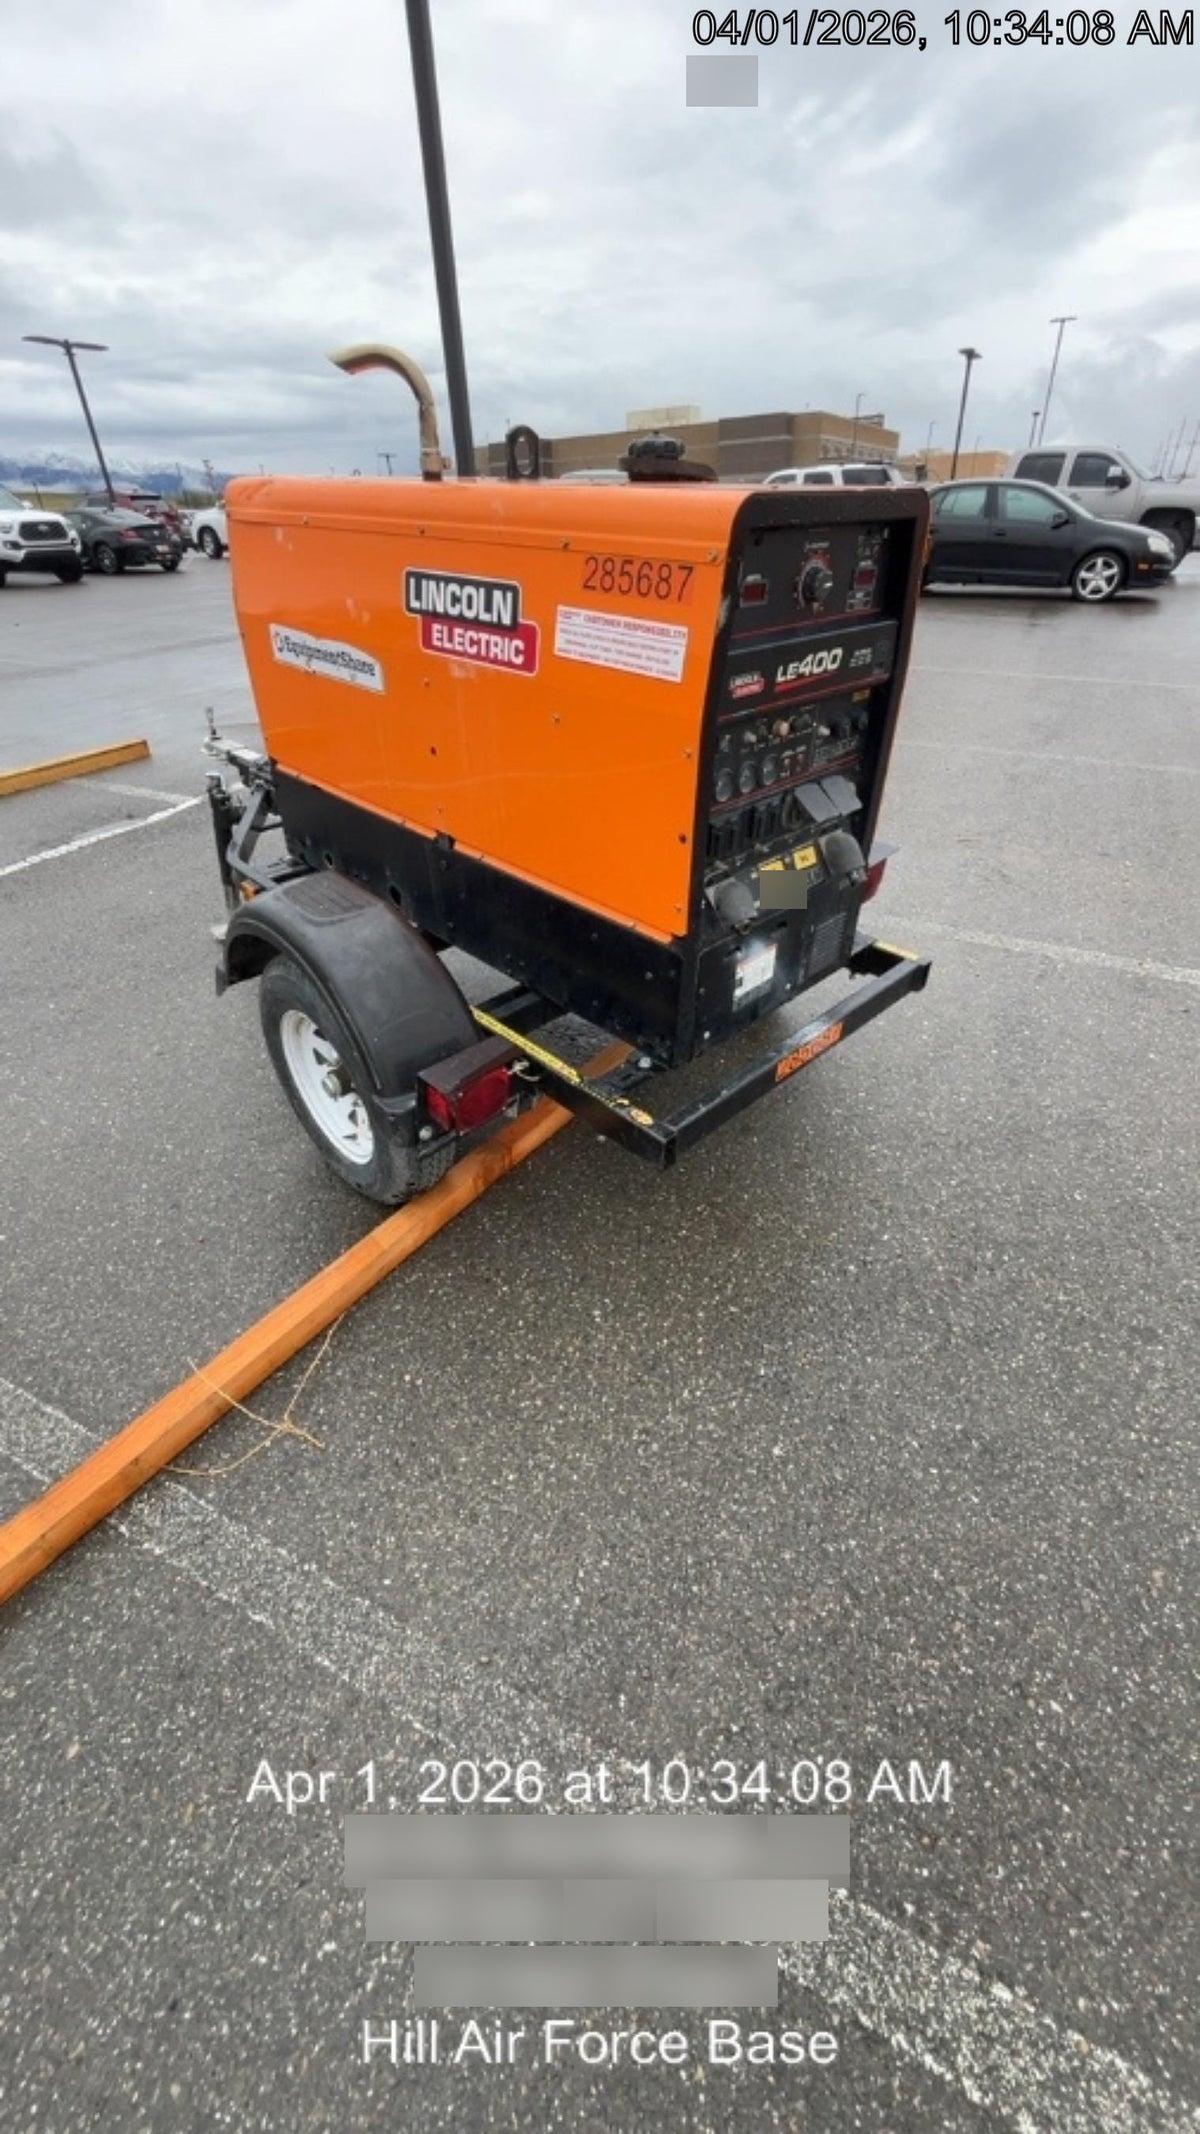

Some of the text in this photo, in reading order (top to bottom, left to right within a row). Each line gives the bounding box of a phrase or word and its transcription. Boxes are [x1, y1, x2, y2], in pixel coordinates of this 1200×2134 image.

[409, 577, 513, 626] LINCOLN
[583, 556, 695, 603] 285687
[431, 623, 525, 665] ELECTRIC
[775, 647, 844, 682] LE400
